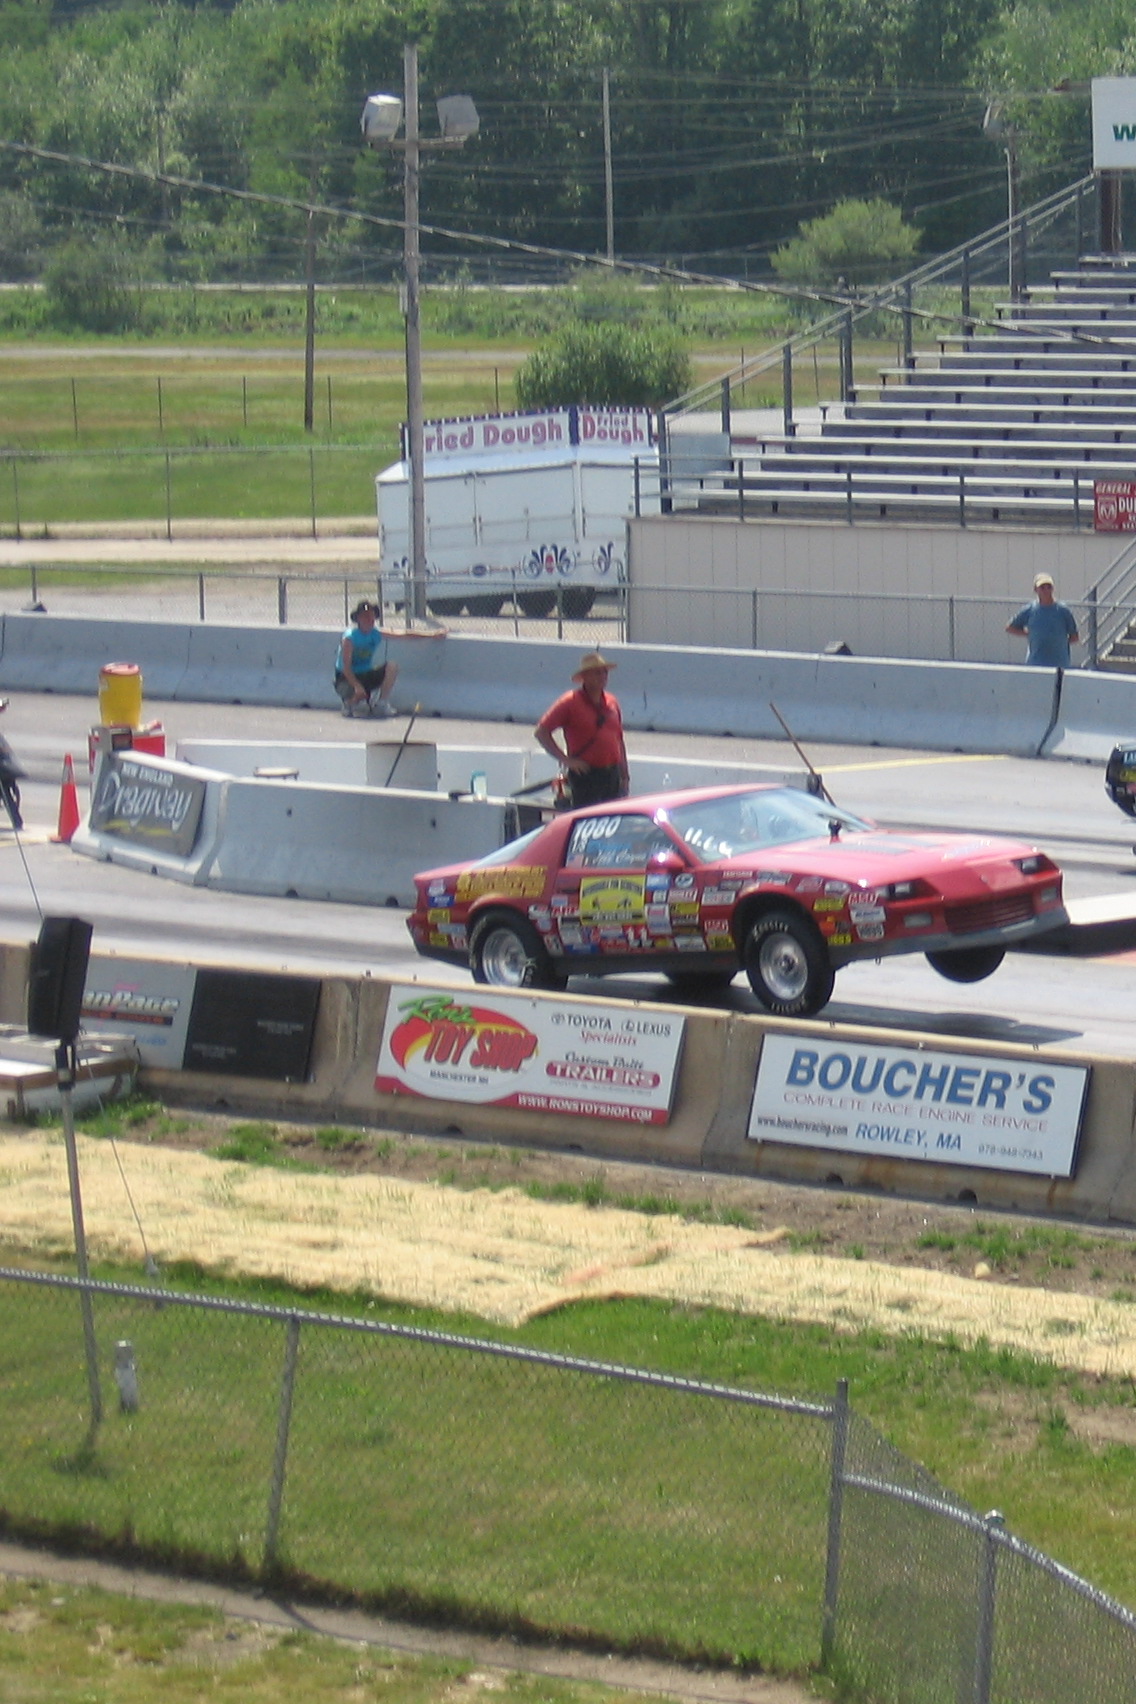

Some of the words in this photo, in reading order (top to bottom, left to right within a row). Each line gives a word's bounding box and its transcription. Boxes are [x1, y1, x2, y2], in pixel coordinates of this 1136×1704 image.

[425, 424, 475, 452] ried
[483, 418, 563, 448] Dough
[582, 414, 645, 446] Dough
[98, 771, 193, 832] Dragway
[567, 1013, 612, 1031] TOYOTA
[636, 1020, 672, 1037] LEXUS
[555, 1063, 654, 1087] TRAILERS
[786, 1050, 1056, 1115] BOUCHER'S
[783, 1091, 863, 1112] COMPLETE
[871, 1101, 911, 1116] RACE
[919, 1105, 975, 1124] ENGINE
[982, 1113, 1048, 1132] SERVICE
[856, 1122, 928, 1148] ROWLEY,
[936, 1132, 962, 1151] MA
